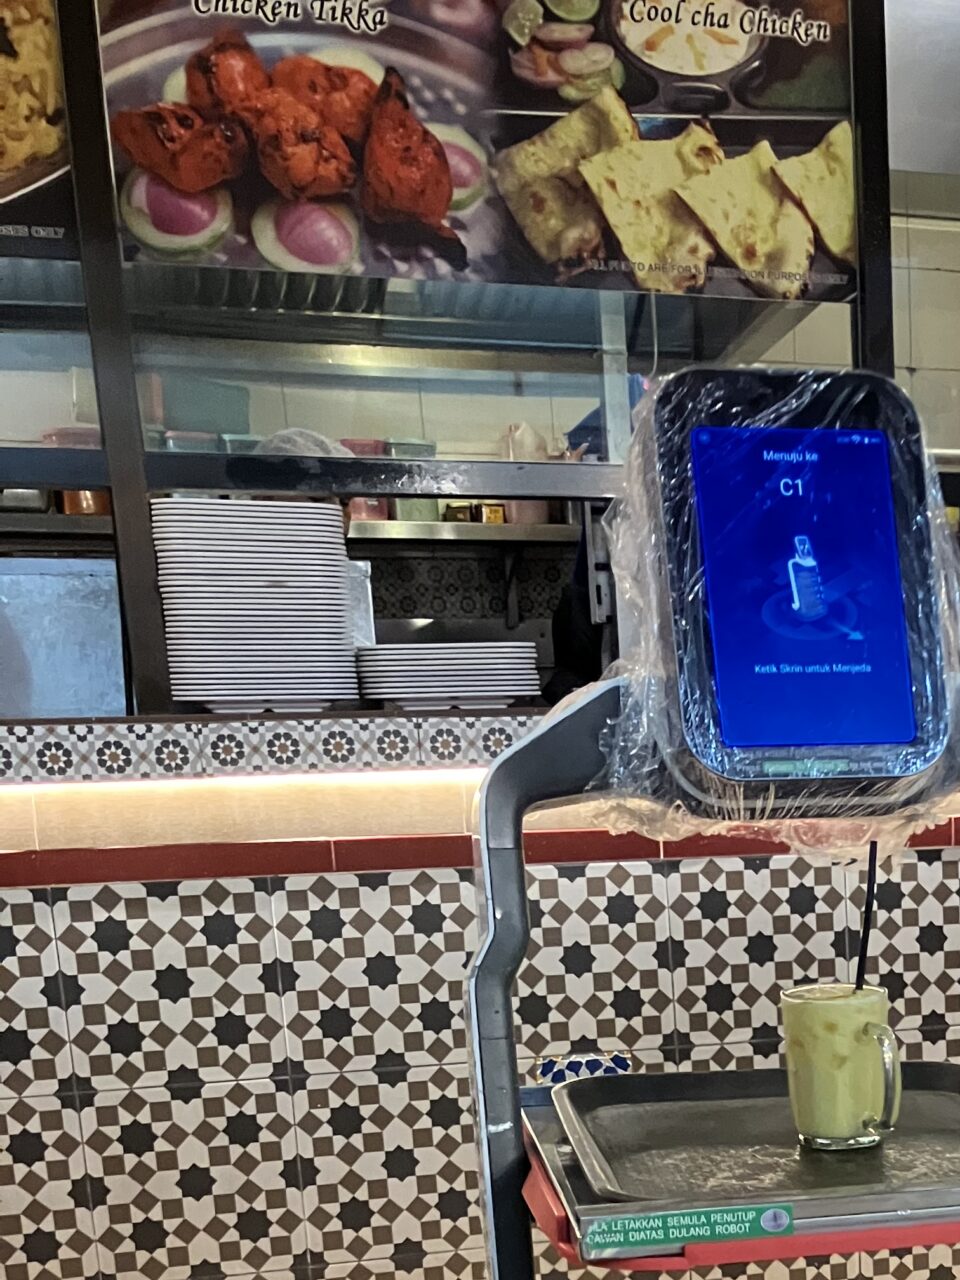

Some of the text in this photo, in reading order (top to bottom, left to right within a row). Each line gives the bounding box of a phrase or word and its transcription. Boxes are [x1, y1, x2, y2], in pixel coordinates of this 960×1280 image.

[194, 0, 386, 32] Chicken Tikka
[629, 0, 830, 45] Cool cha Chicken
[763, 450, 819, 464] Menuju ke
[780, 478, 803, 496] C1
[755, 663, 872, 675] Ketik Skrin untuk Menjeda
[611, 1218, 663, 1231] LETAKKAN
[667, 1214, 707, 1227] SEMULA
[711, 1211, 756, 1223] PENUTUP
[629, 1229, 664, 1241] DIATAS
[669, 1226, 710, 1239] DULANG
[715, 1223, 751, 1235] ROBOT
